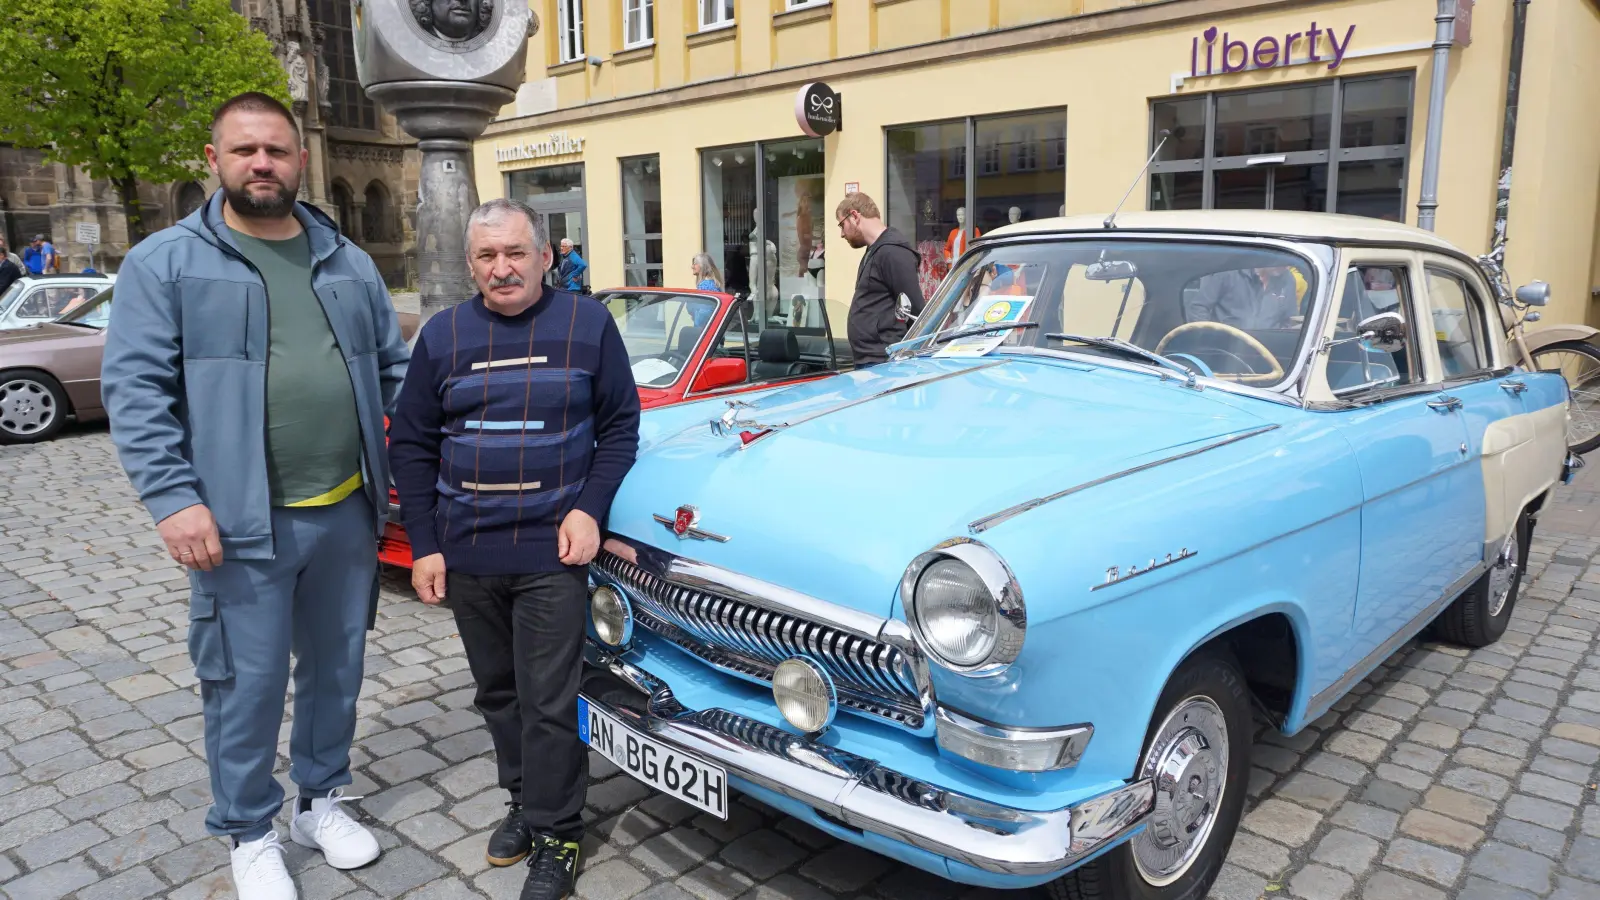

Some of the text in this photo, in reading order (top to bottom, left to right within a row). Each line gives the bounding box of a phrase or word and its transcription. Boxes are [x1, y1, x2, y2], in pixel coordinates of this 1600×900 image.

[1191, 21, 1357, 77] liberty
[590, 712, 723, 813] AN BG 62H
